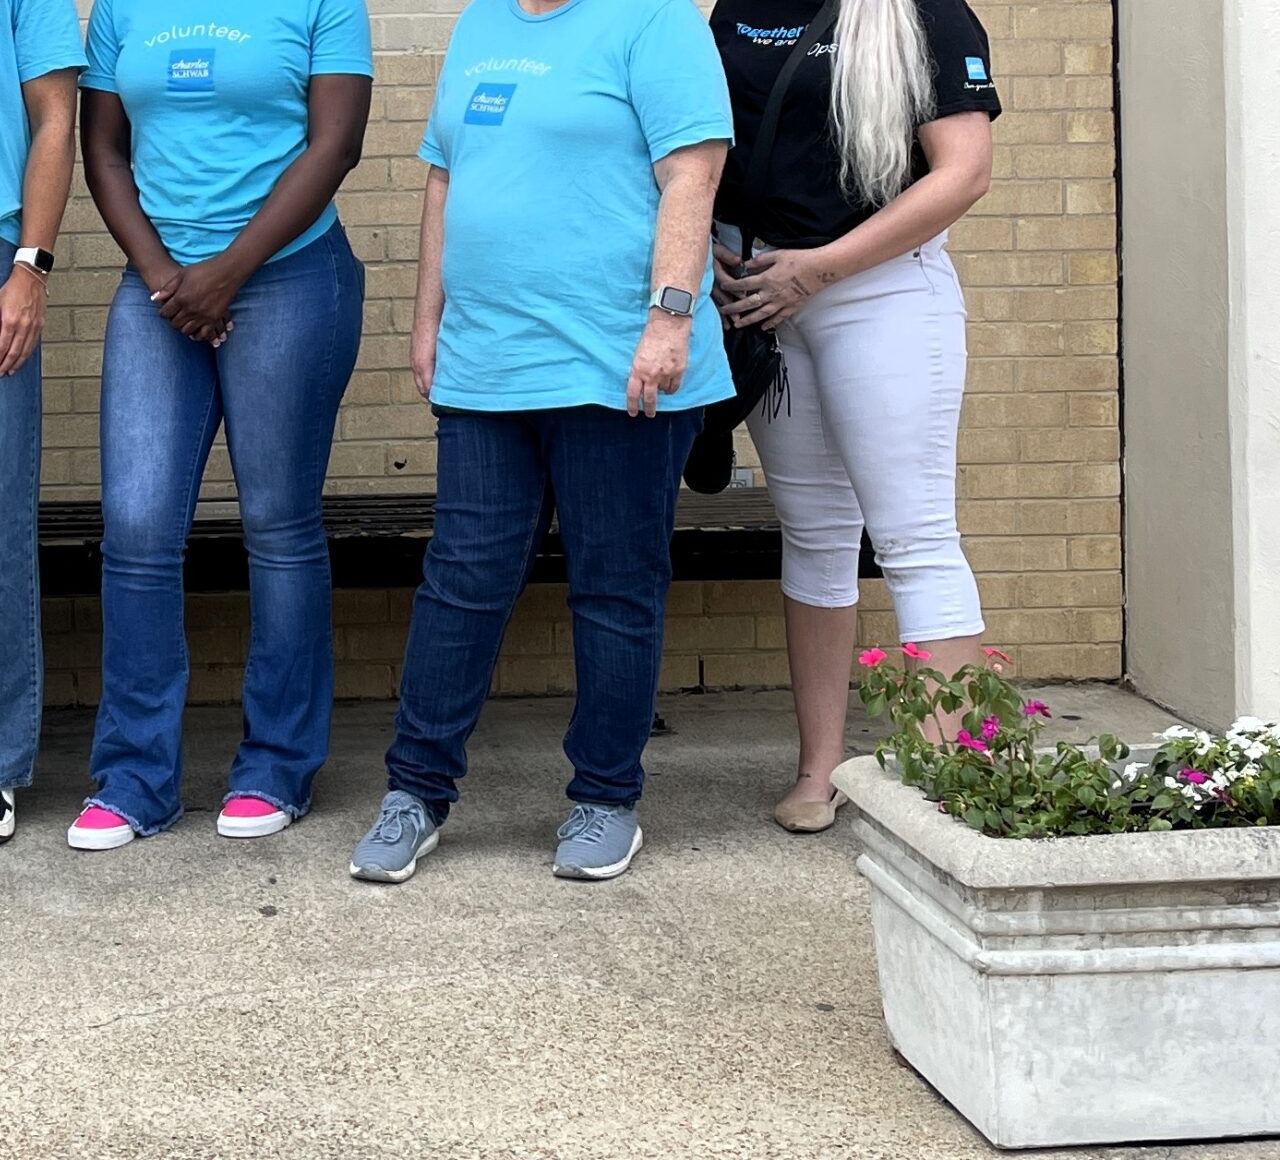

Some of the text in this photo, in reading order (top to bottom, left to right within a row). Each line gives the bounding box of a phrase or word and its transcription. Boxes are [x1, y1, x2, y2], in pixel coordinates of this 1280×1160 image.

[144, 22, 251, 47] volunteer
[171, 69, 209, 79] SCHWAB
[464, 57, 552, 77] volunteer
